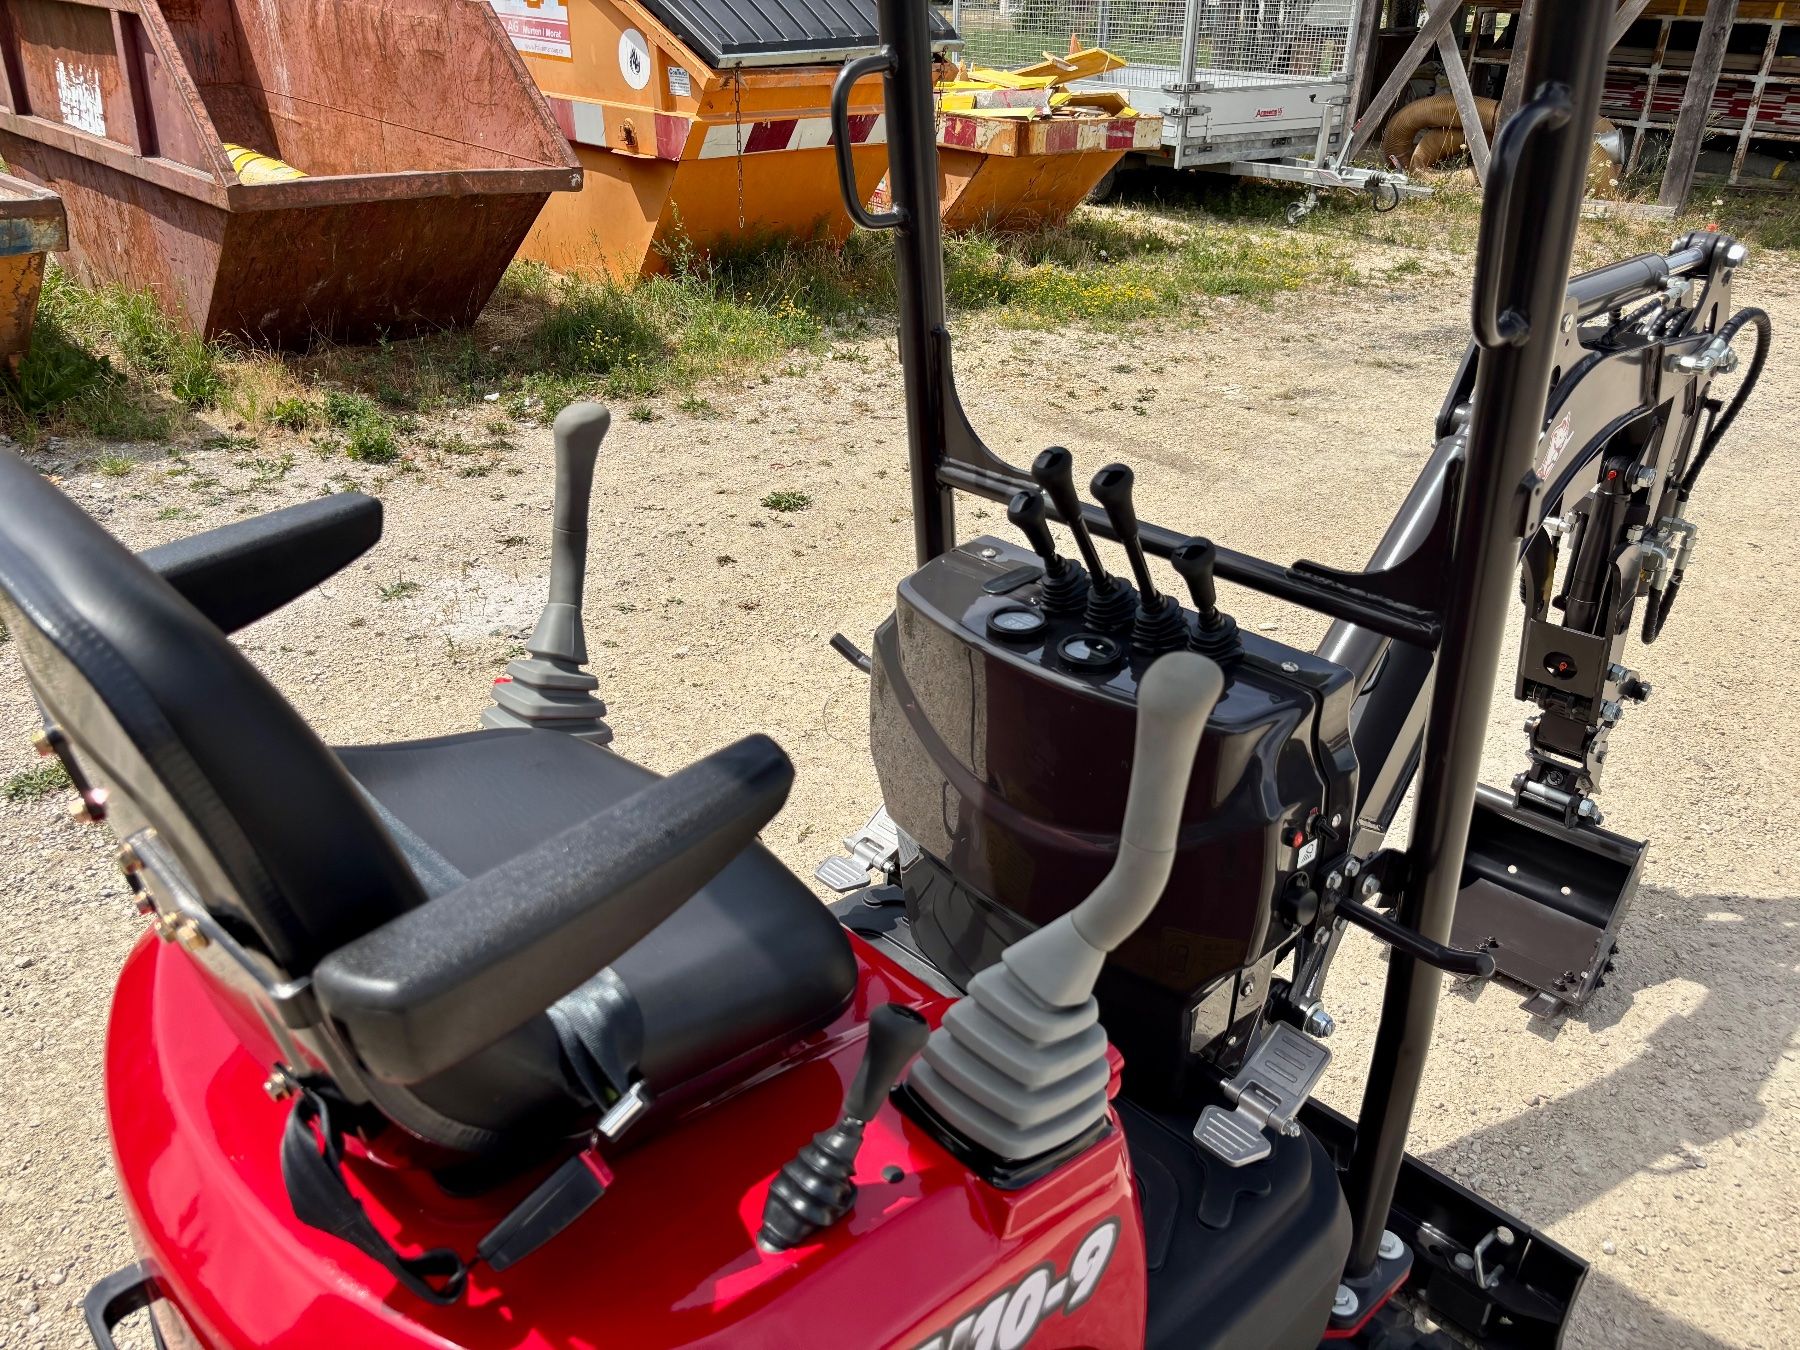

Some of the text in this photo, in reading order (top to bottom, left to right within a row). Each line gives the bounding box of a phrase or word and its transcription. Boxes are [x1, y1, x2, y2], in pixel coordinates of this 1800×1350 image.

[508, 19, 519, 32] AG
[545, 28, 562, 38] Morat
[912, 1216, 1121, 1350] 10-9
